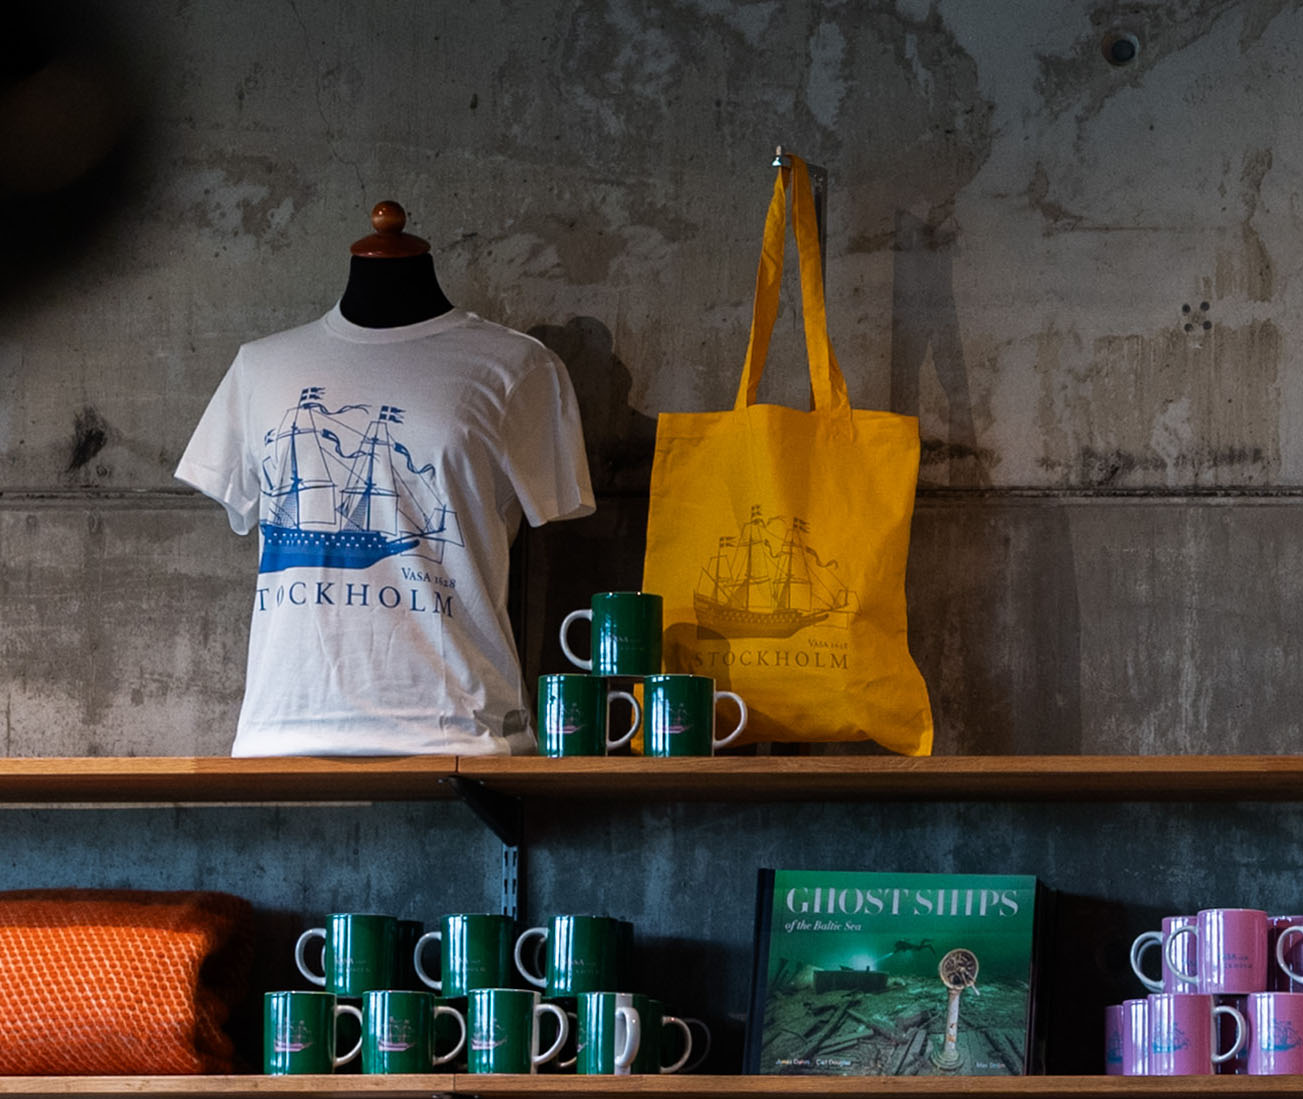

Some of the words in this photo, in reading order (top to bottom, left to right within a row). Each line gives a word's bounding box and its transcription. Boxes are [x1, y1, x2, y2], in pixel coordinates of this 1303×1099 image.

[256, 581, 454, 618] TOCKHOLM
[694, 649, 849, 671] STOCKHOLM
[786, 887, 909, 916] GHOST
[913, 888, 1019, 918] SHIPS
[785, 920, 796, 931] of
[797, 919, 812, 931] the
[813, 919, 841, 932] Baltic
[844, 920, 862, 932] Sea
